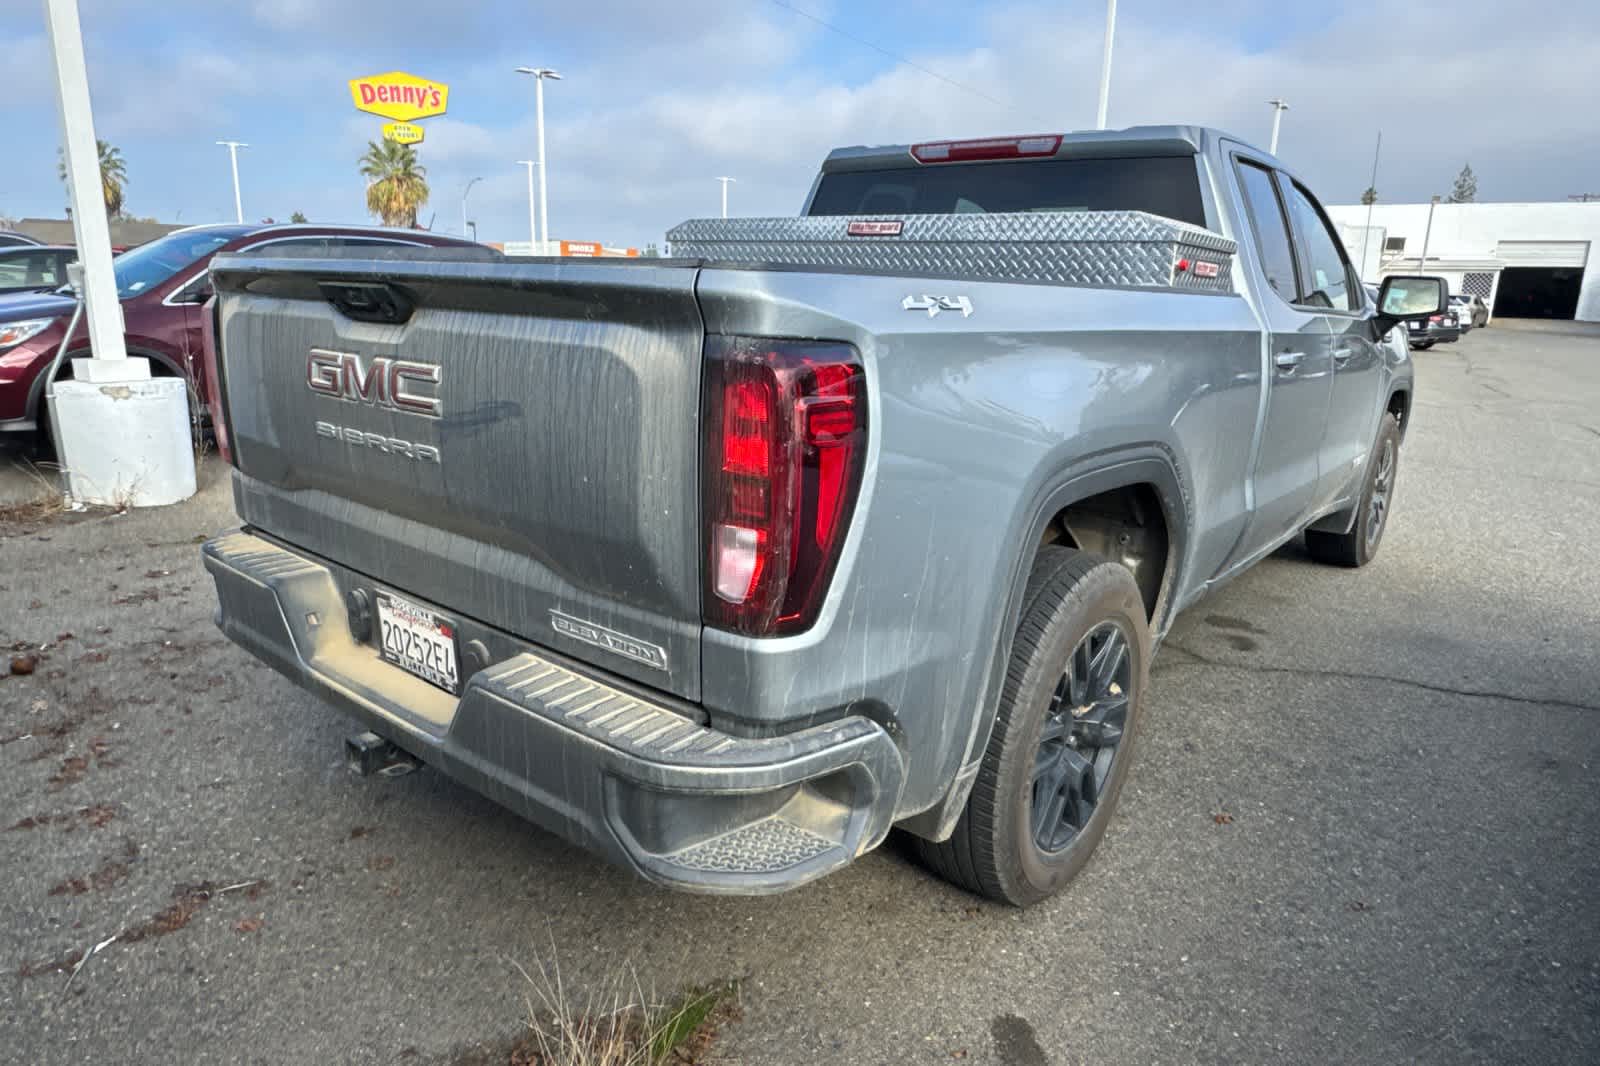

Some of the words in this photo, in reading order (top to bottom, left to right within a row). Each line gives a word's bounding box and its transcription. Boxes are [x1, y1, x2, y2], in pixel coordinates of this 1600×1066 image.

[359, 83, 441, 108] Denny's
[307, 348, 443, 420] GMC
[315, 420, 441, 464] SIERRA
[383, 620, 456, 681] 20252E4
[557, 617, 658, 663] ELEVATION
